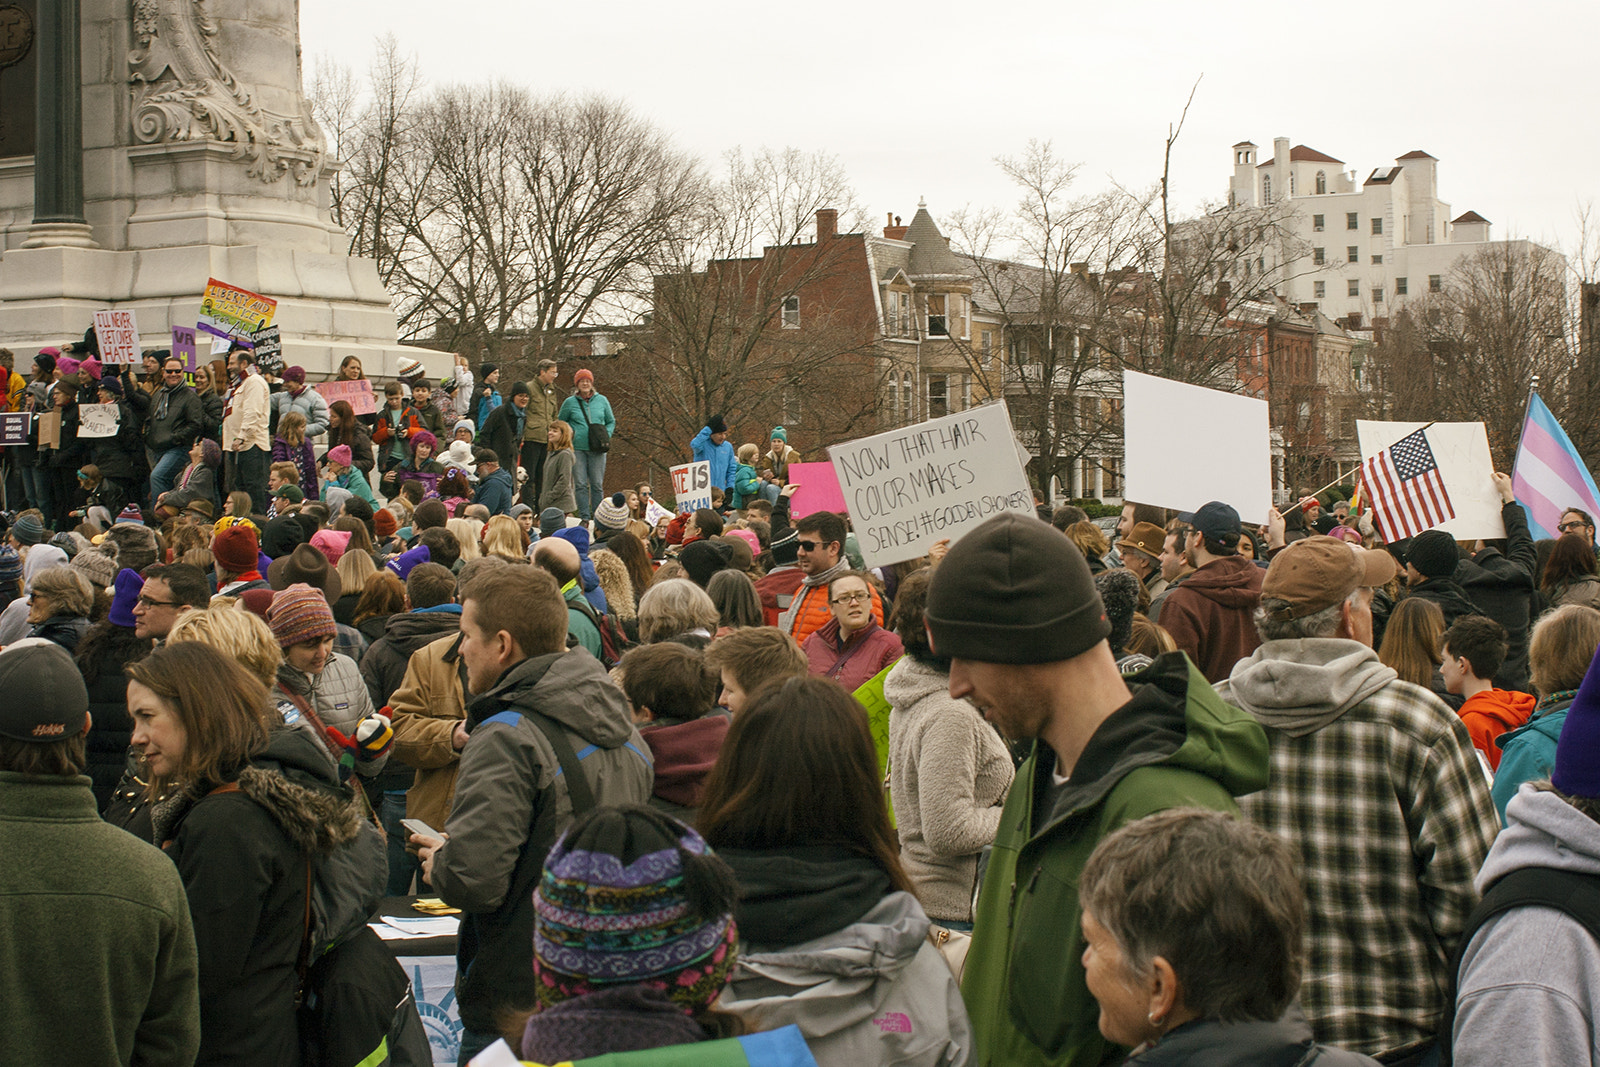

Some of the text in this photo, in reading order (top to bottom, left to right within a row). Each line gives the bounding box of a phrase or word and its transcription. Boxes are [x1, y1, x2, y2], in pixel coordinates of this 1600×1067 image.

[210, 286, 270, 313] LIBERTY AND
[214, 298, 259, 321] JUSTICE
[110, 312, 134, 329] NEVER
[227, 321, 253, 338] ALL
[174, 329, 196, 347] VA
[102, 345, 135, 363] HATE
[180, 351, 188, 367] 4
[840, 418, 988, 487] NOW THAT HAIR
[692, 464, 709, 491] IS
[854, 459, 976, 521] COLOR MAKES
[868, 515, 920, 553] SENSE!
